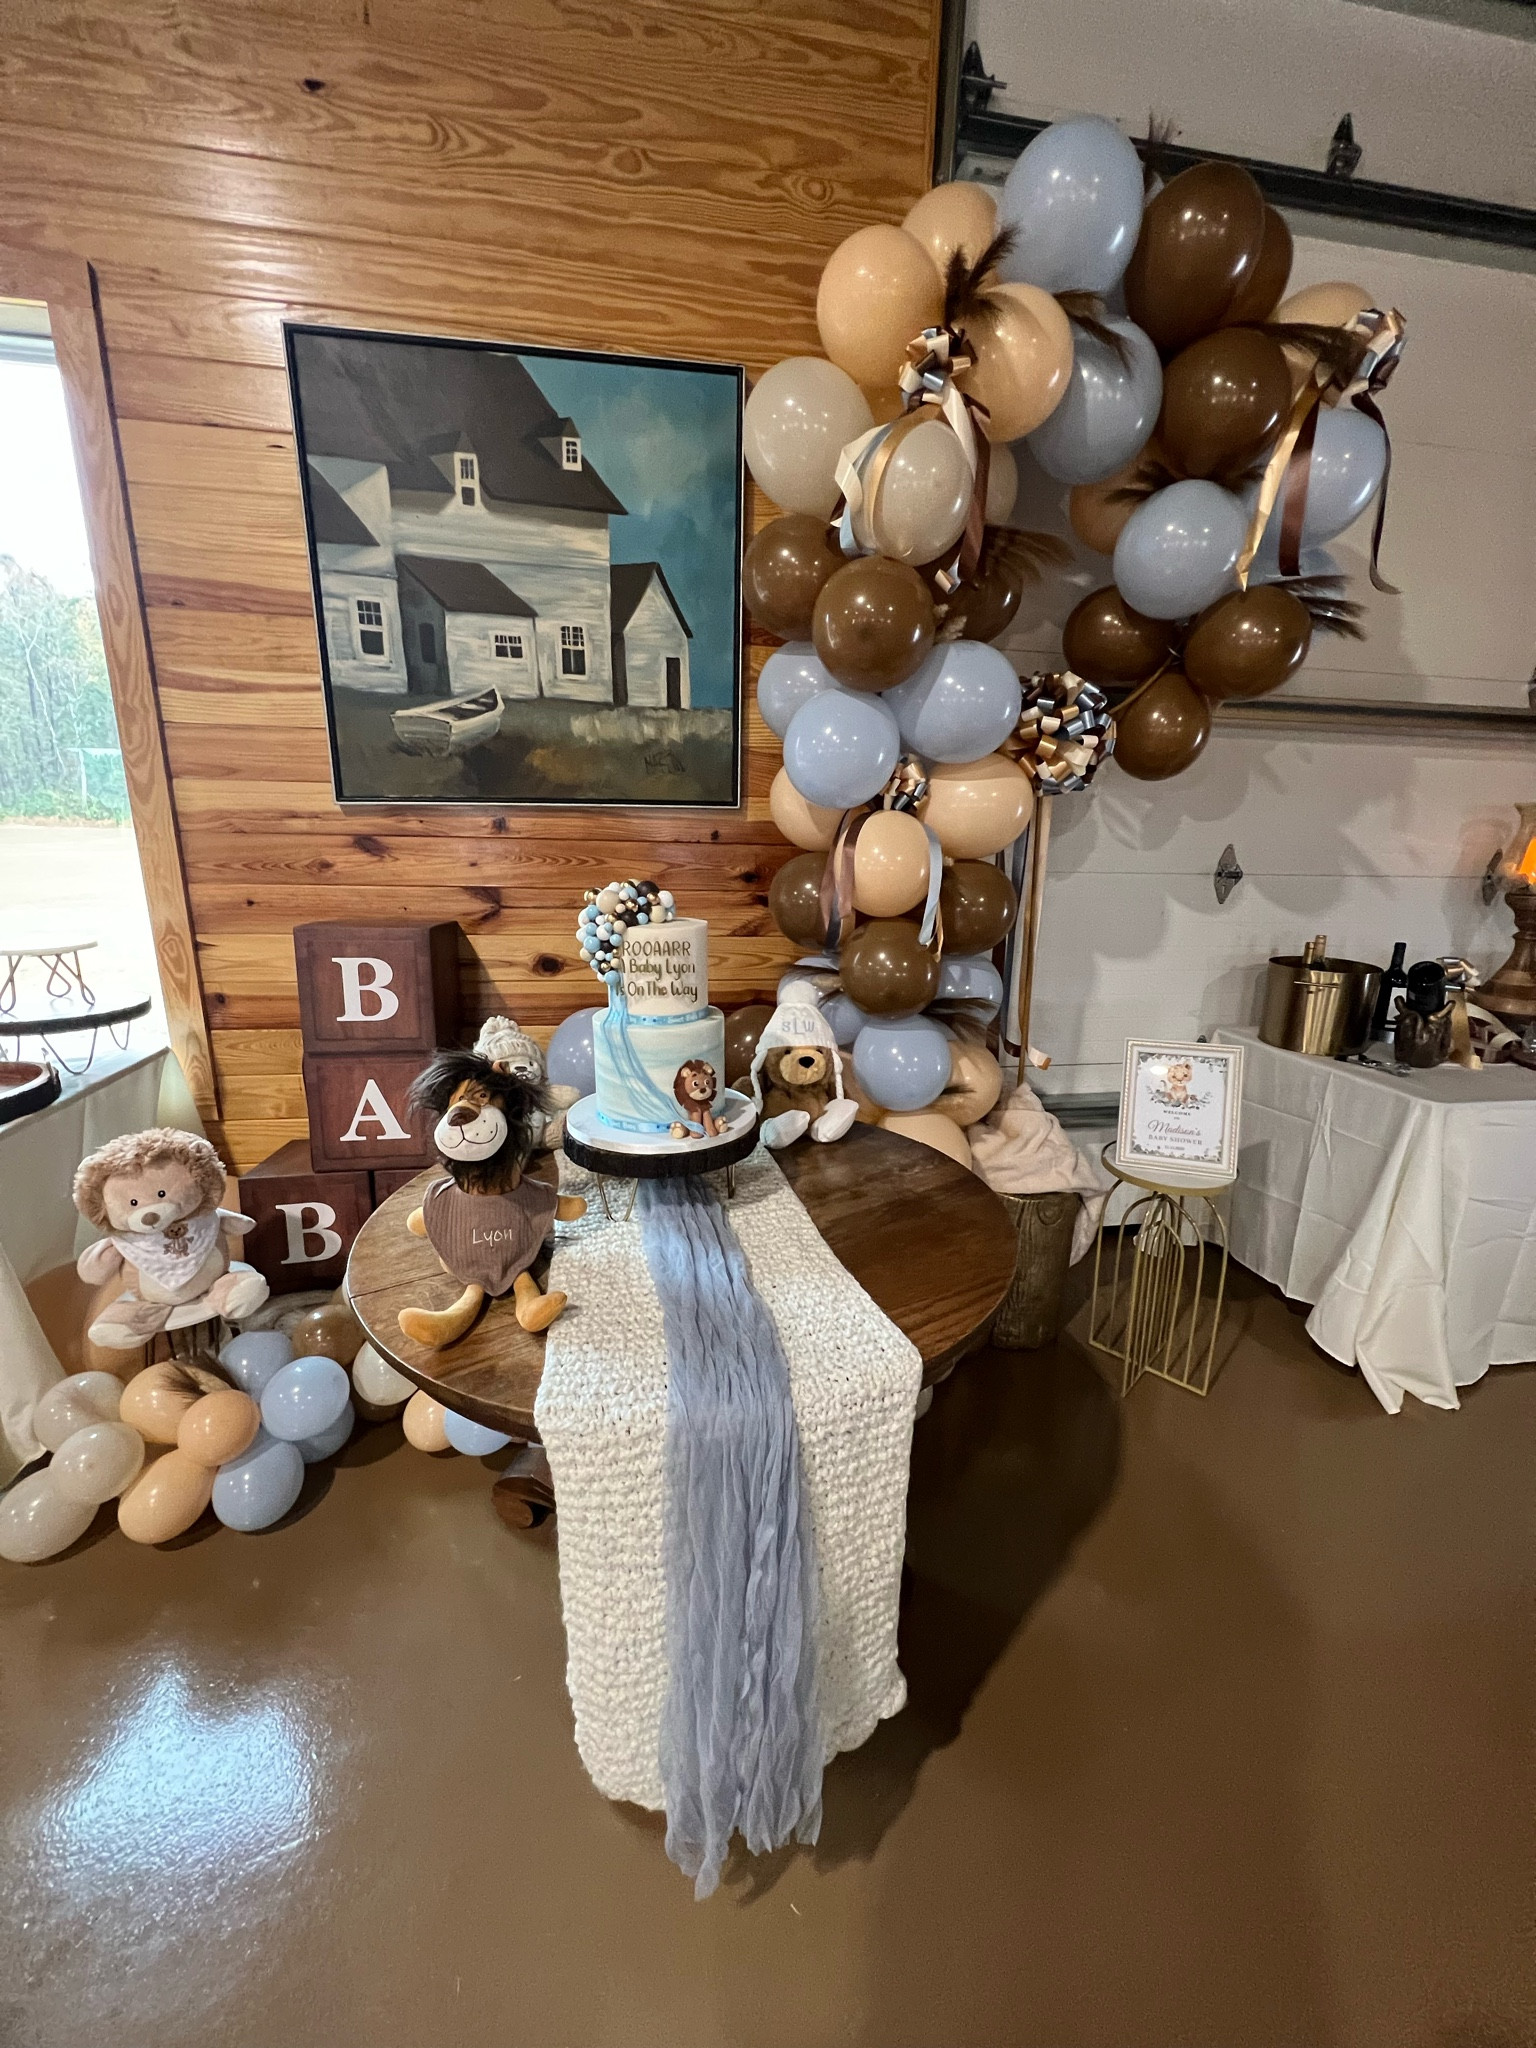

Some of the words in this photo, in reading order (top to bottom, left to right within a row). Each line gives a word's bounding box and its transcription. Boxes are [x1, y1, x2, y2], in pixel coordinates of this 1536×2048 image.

[629, 958, 662, 981] Baby
[666, 958, 696, 981] Lyon
[331, 957, 399, 1022] B
[627, 981, 645, 996] On
[647, 981, 668, 996] The
[671, 981, 698, 1003] Way
[339, 1078, 411, 1142] A
[1148, 1120, 1201, 1136] Madison's
[275, 1201, 342, 1266] B
[472, 1227, 513, 1248] Lyon
